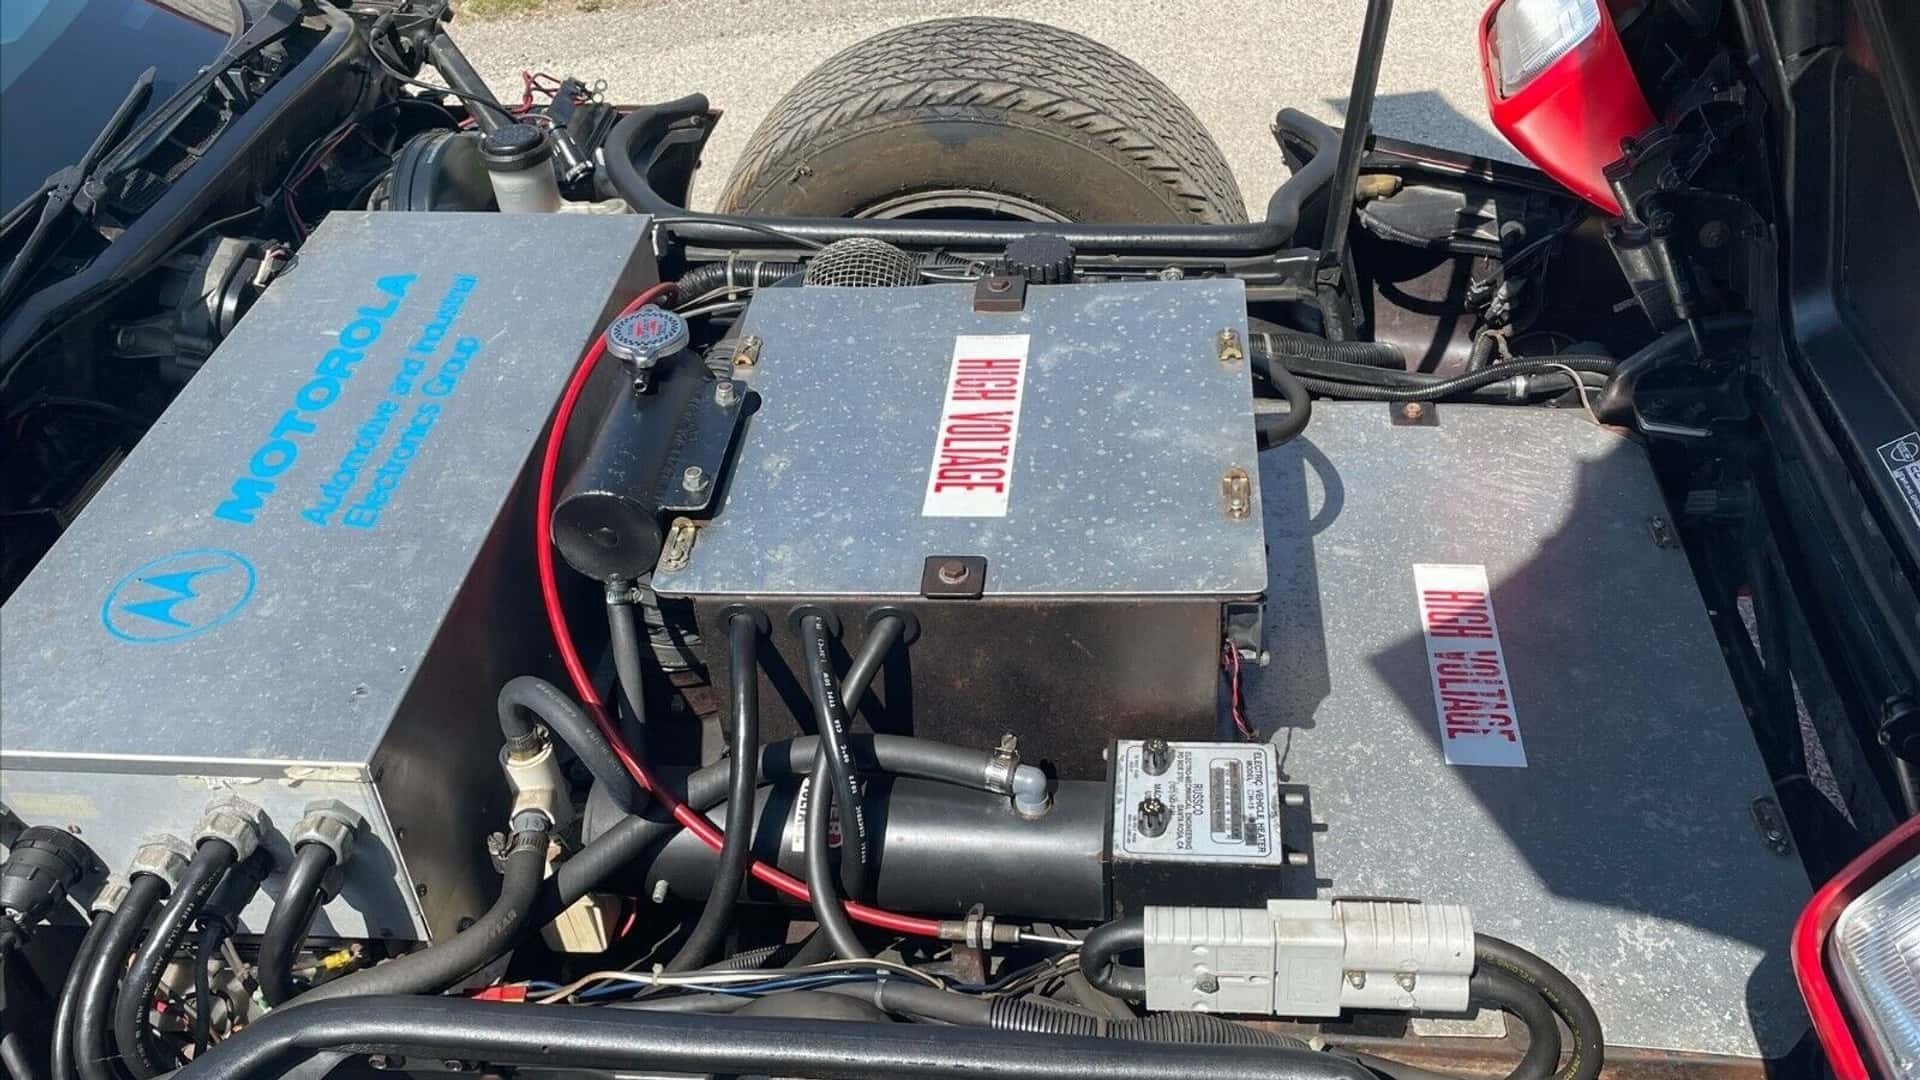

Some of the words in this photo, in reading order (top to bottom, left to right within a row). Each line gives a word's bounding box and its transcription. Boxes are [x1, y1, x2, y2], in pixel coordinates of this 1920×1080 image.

[952, 359, 1021, 400] HIGH
[213, 273, 419, 526] MOTOROLA
[301, 400, 400, 528] Automotive
[389, 357, 425, 397] and
[408, 273, 480, 354] Industrial
[342, 402, 442, 530] Electronics
[421, 335, 482, 398] Group
[934, 411, 1014, 493] VOLTAGE
[1423, 590, 1494, 639] HIGH
[826, 691, 836, 708] TYPE
[1434, 651, 1517, 742] VOLTAGE
[834, 719, 843, 734] CSA
[1253, 752, 1264, 787] ELECTRIC
[1192, 784, 1204, 816] RUSSCO
[1256, 789, 1265, 820] VEHICLE
[1185, 812, 1193, 850] ENGINEERING
[1256, 823, 1266, 853] HEATER
